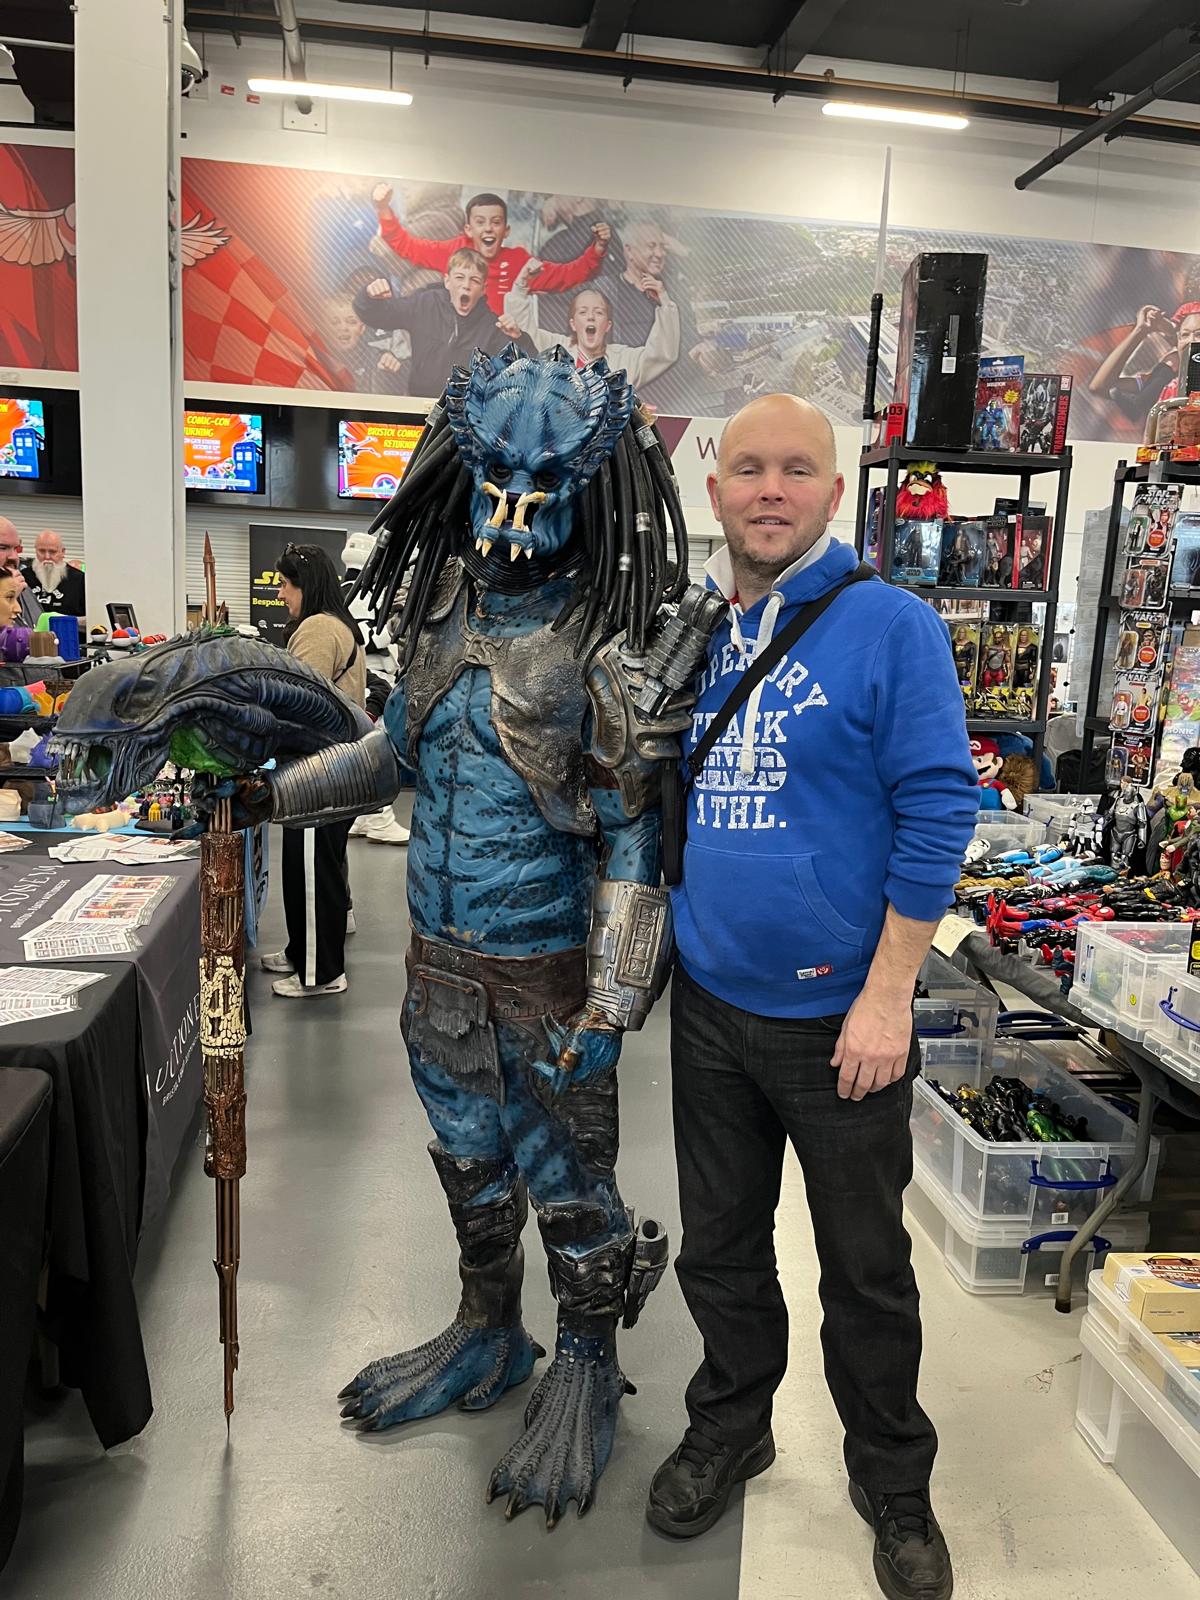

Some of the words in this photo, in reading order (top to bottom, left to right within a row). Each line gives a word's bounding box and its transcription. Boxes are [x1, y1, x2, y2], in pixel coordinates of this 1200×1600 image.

[889, 405, 903, 416] 03
[186, 415, 231, 426] COMIC-CON
[1052, 395, 1070, 454] TRANSFORMERS
[367, 427, 395, 437] BRISTOL
[252, 597, 285, 608] Bespoke
